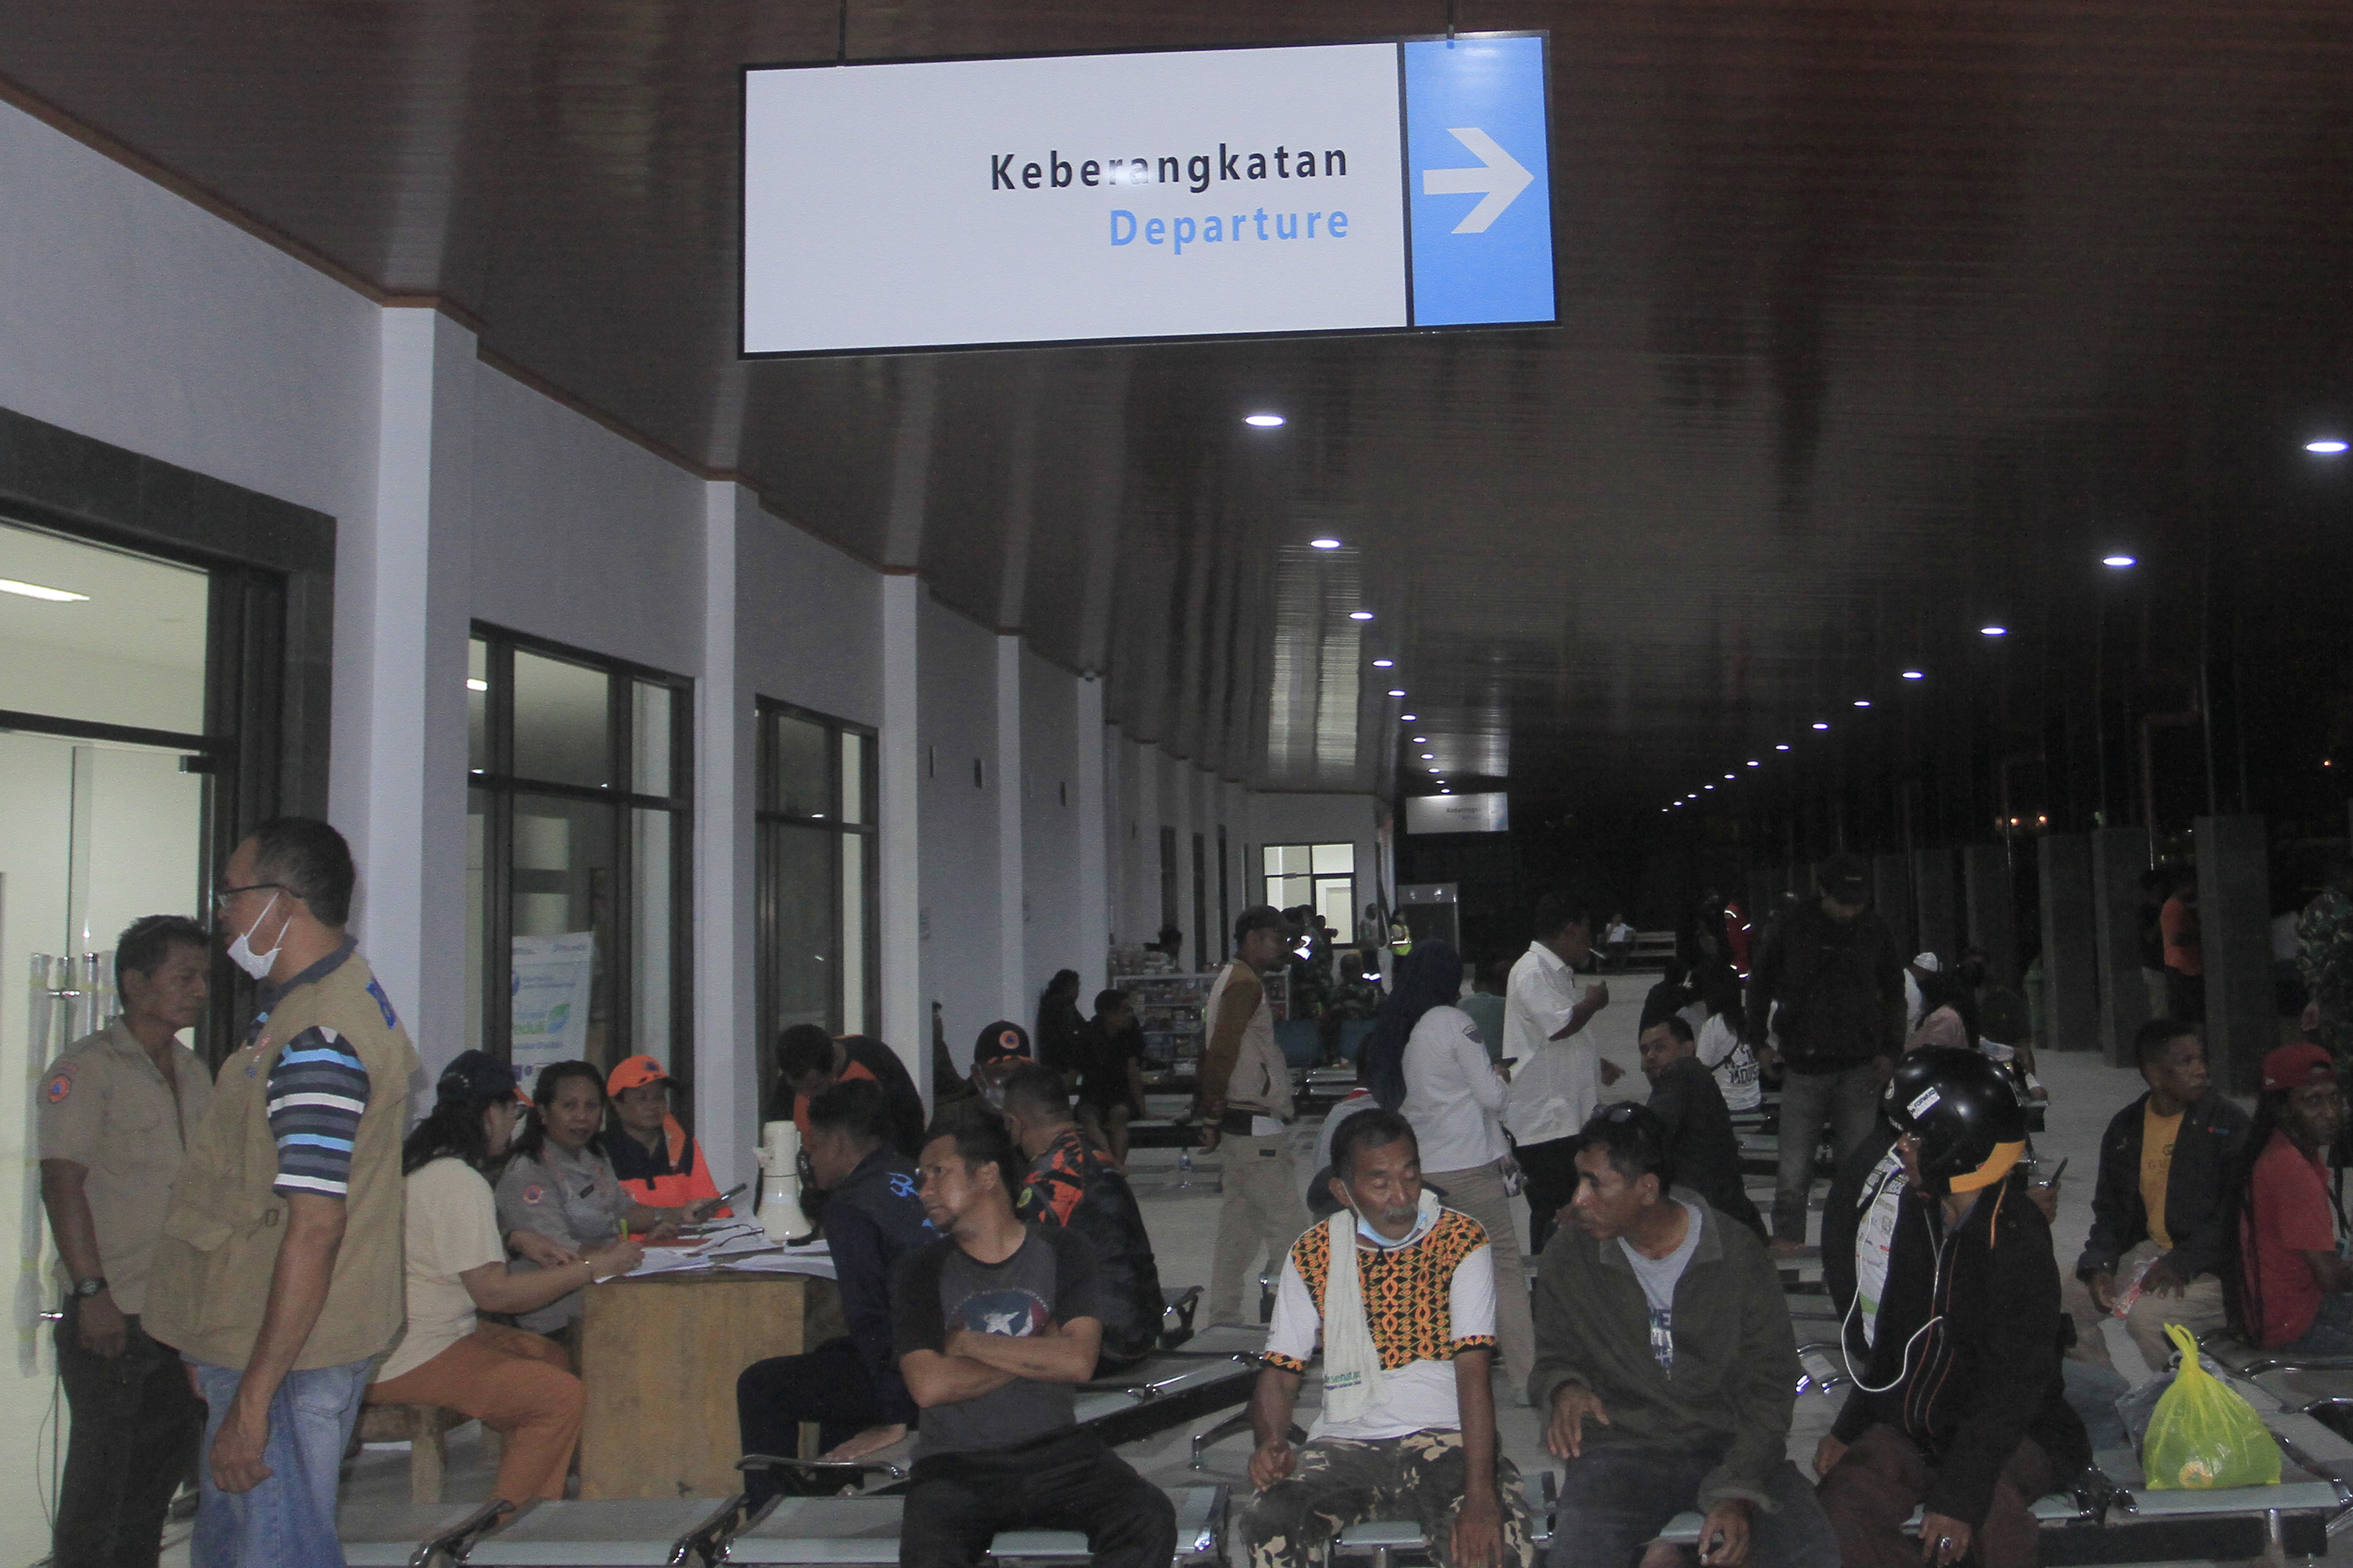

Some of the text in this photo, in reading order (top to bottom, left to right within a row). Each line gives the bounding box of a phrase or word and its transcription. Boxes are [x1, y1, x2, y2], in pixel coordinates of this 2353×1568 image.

[991, 143, 1347, 193] Keberangkatan
[1111, 208, 1348, 255] Departure
[1914, 1089, 1937, 1109] FORWARD
